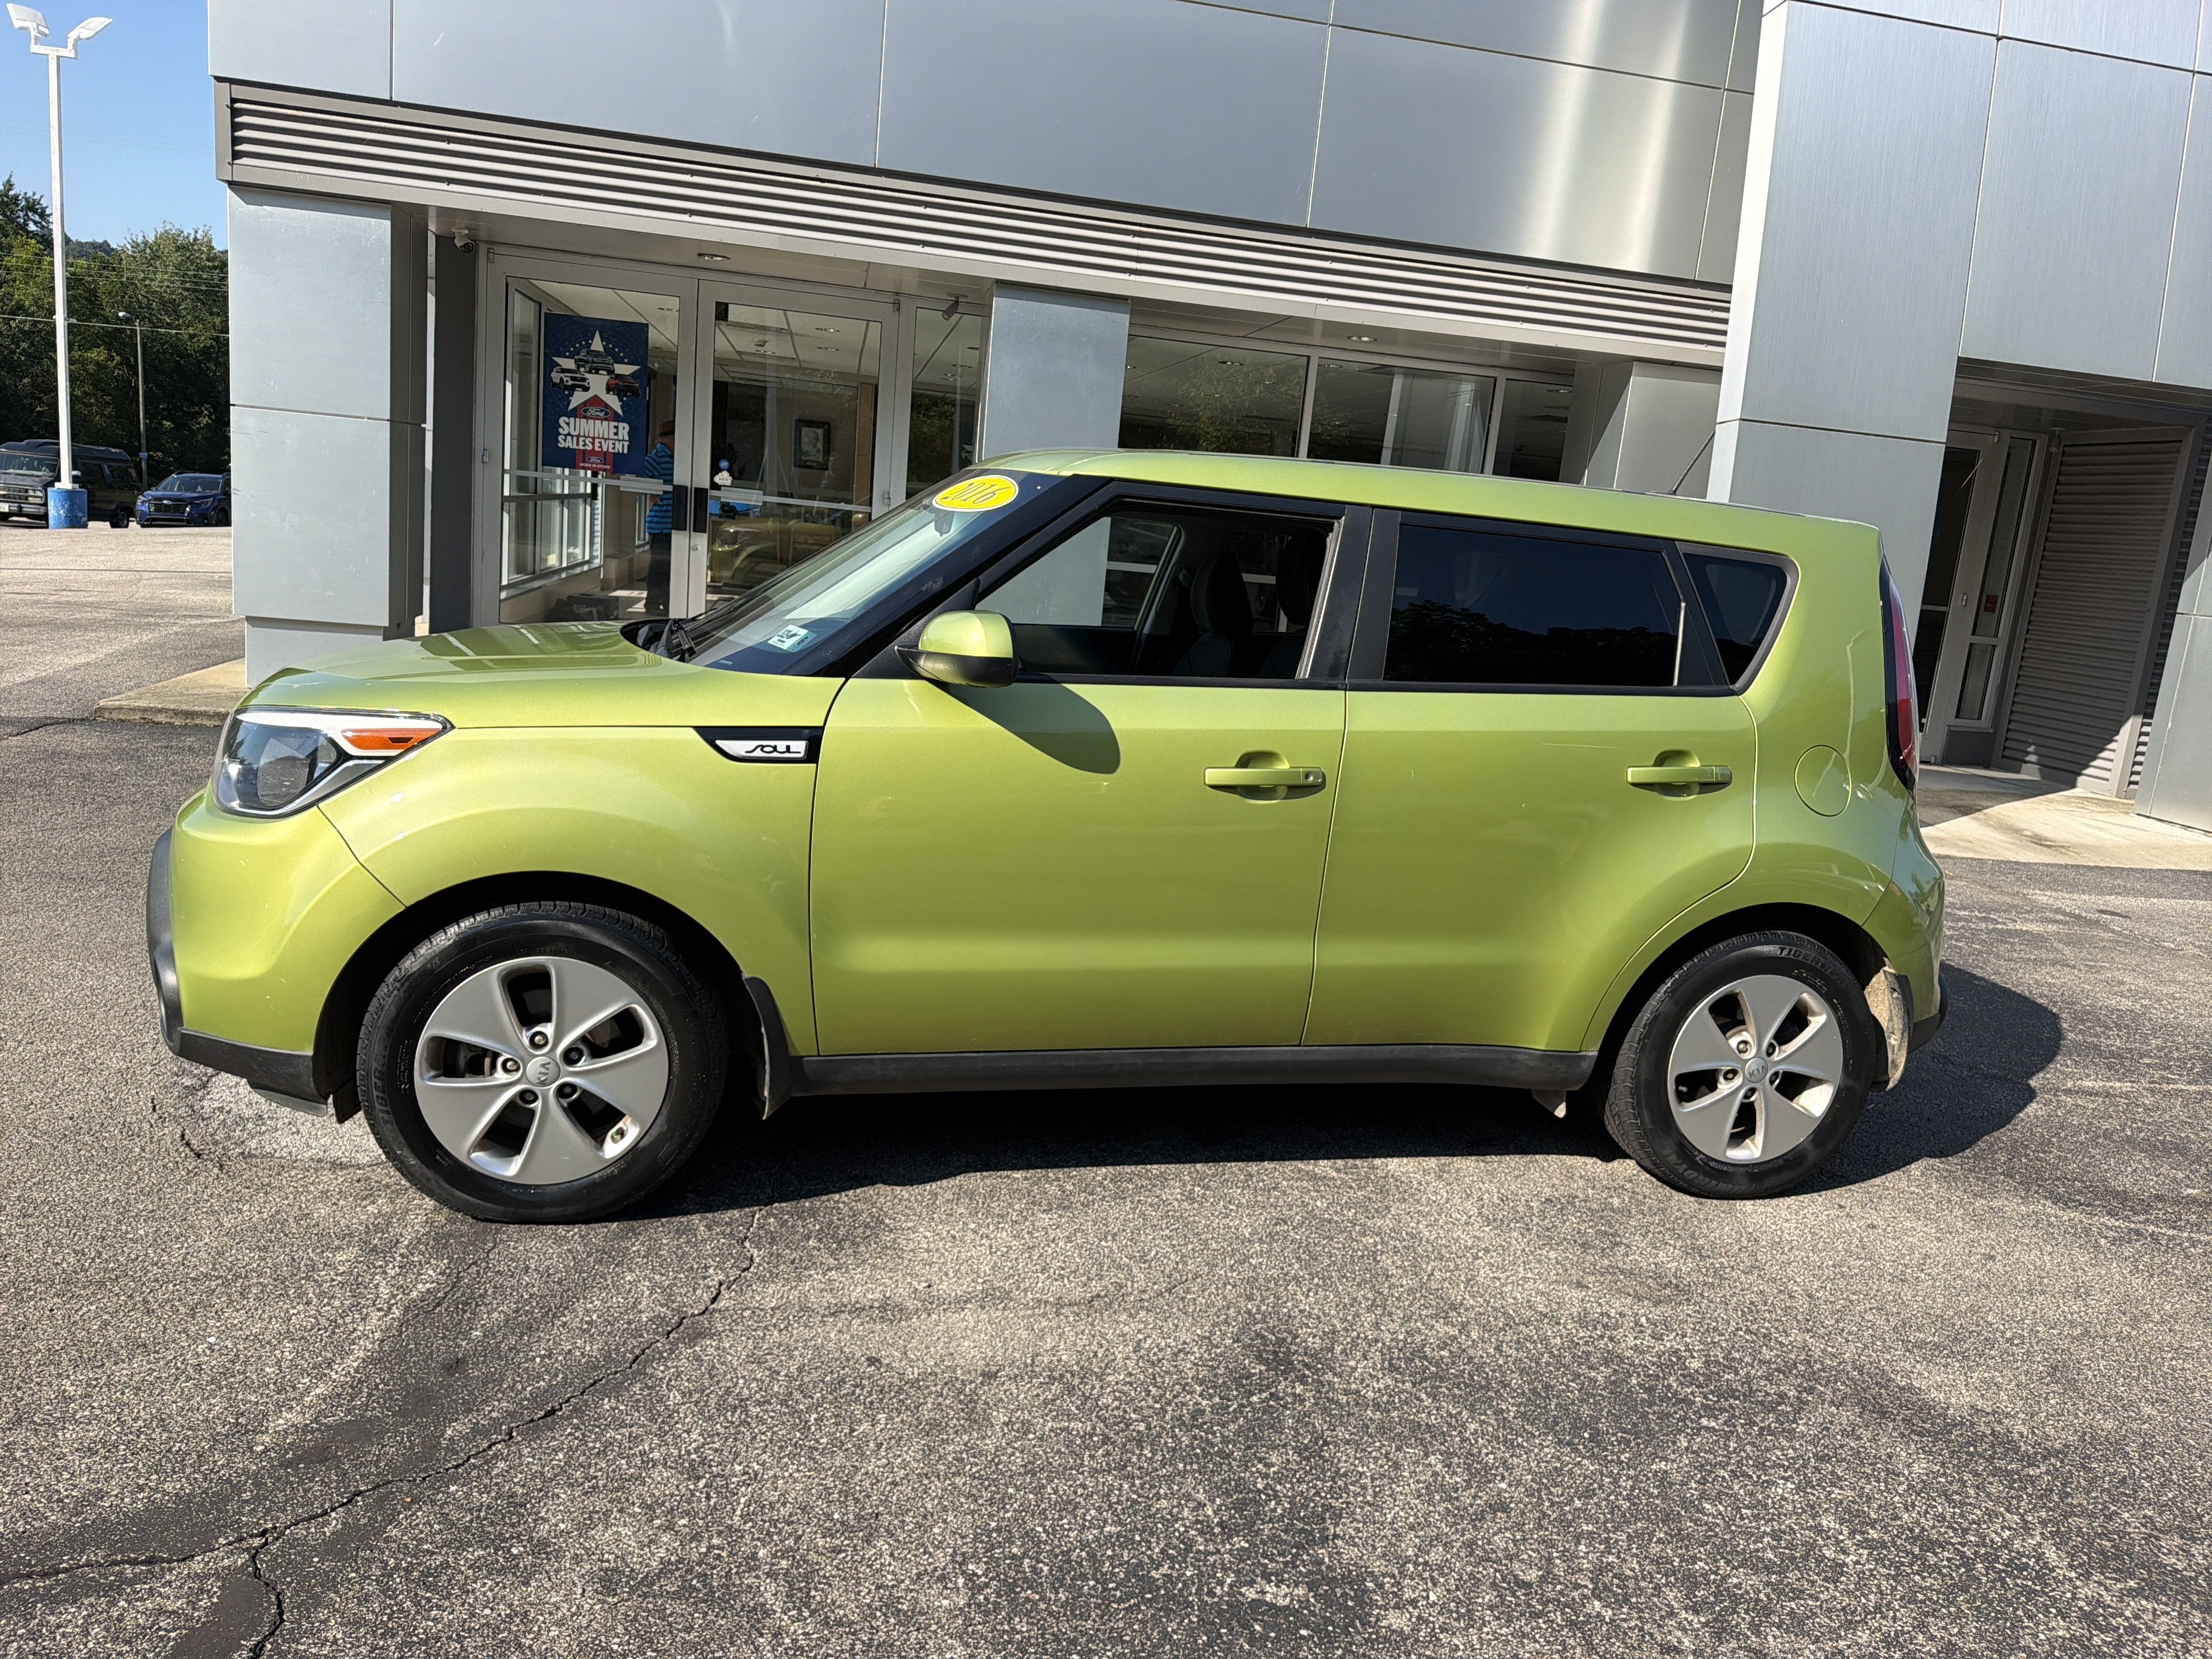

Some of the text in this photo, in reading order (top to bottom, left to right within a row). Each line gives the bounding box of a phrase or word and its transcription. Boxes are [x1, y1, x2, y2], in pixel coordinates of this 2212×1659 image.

[558, 416, 630, 441] SUMMER
[557, 435, 629, 454] SALES EVENT
[536, 1061, 551, 1085] KIA
[1748, 1064, 1767, 1079] KIA
